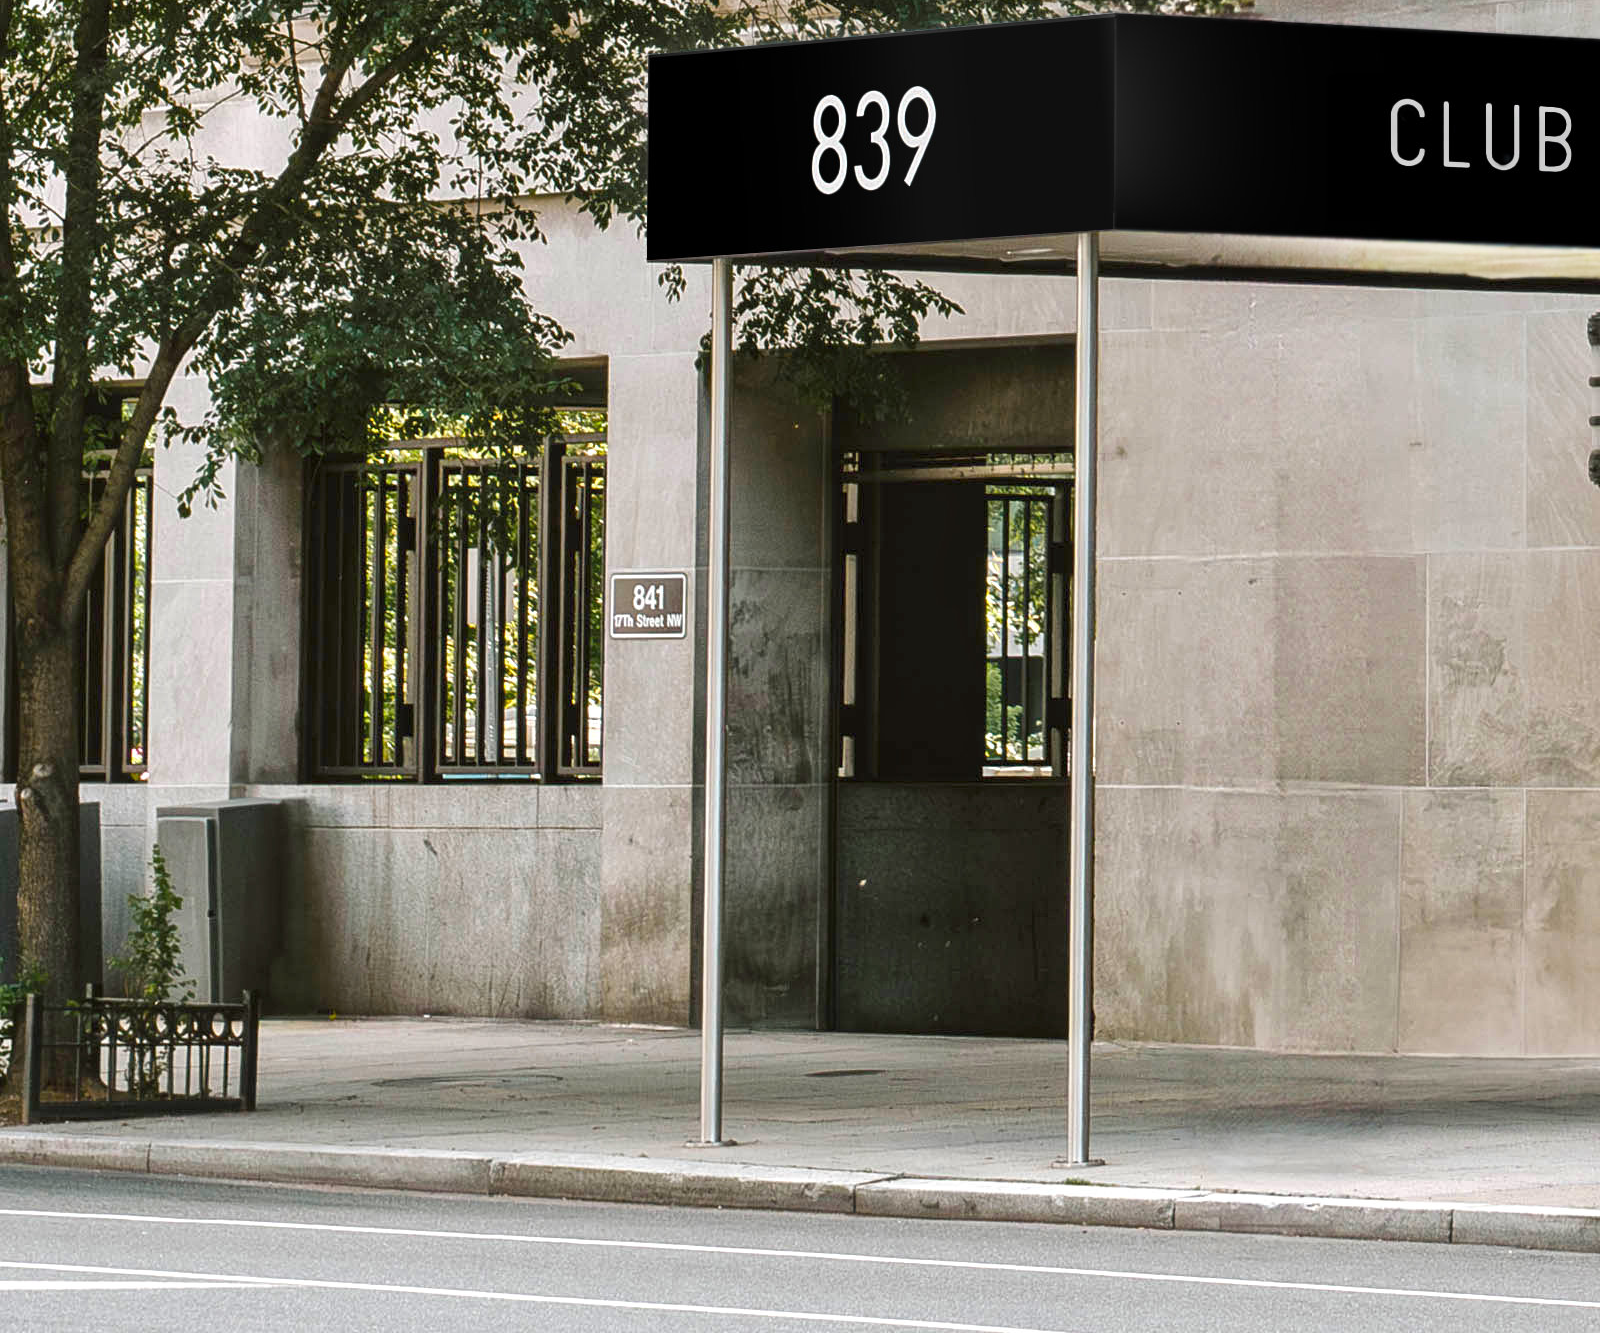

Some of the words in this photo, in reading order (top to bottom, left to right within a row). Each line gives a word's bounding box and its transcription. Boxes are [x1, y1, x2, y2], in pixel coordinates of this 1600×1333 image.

[811, 85, 937, 195] 839
[1390, 98, 1573, 173] CLUB
[632, 584, 664, 611] 841
[636, 613, 664, 628] Street
[667, 613, 682, 628] NW
